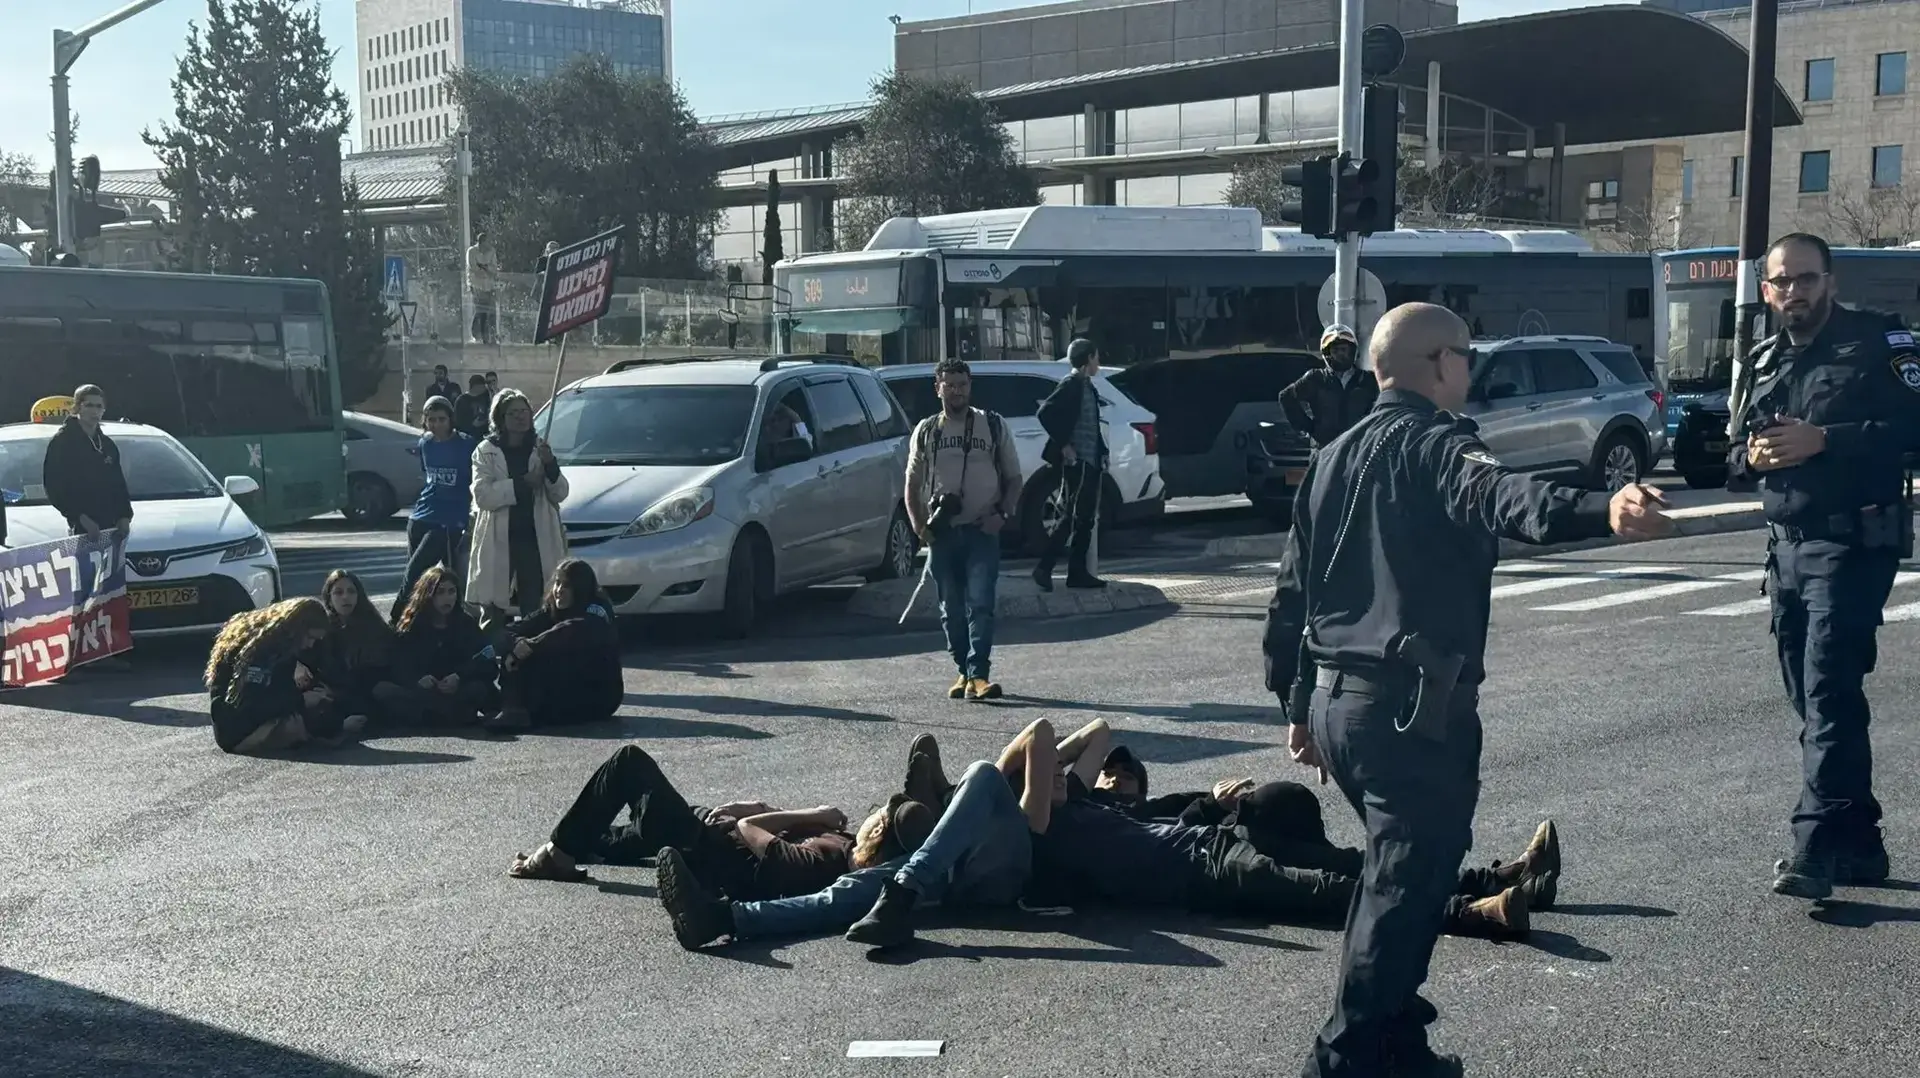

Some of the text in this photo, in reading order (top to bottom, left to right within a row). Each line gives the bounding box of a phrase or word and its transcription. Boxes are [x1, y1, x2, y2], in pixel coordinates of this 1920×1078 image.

[582, 241, 601, 261] לכם
[602, 236, 618, 257] אין
[555, 259, 608, 300] להיכנע
[1689, 259, 1738, 279] בעת רם
[547, 284, 606, 329] לחמאס!
